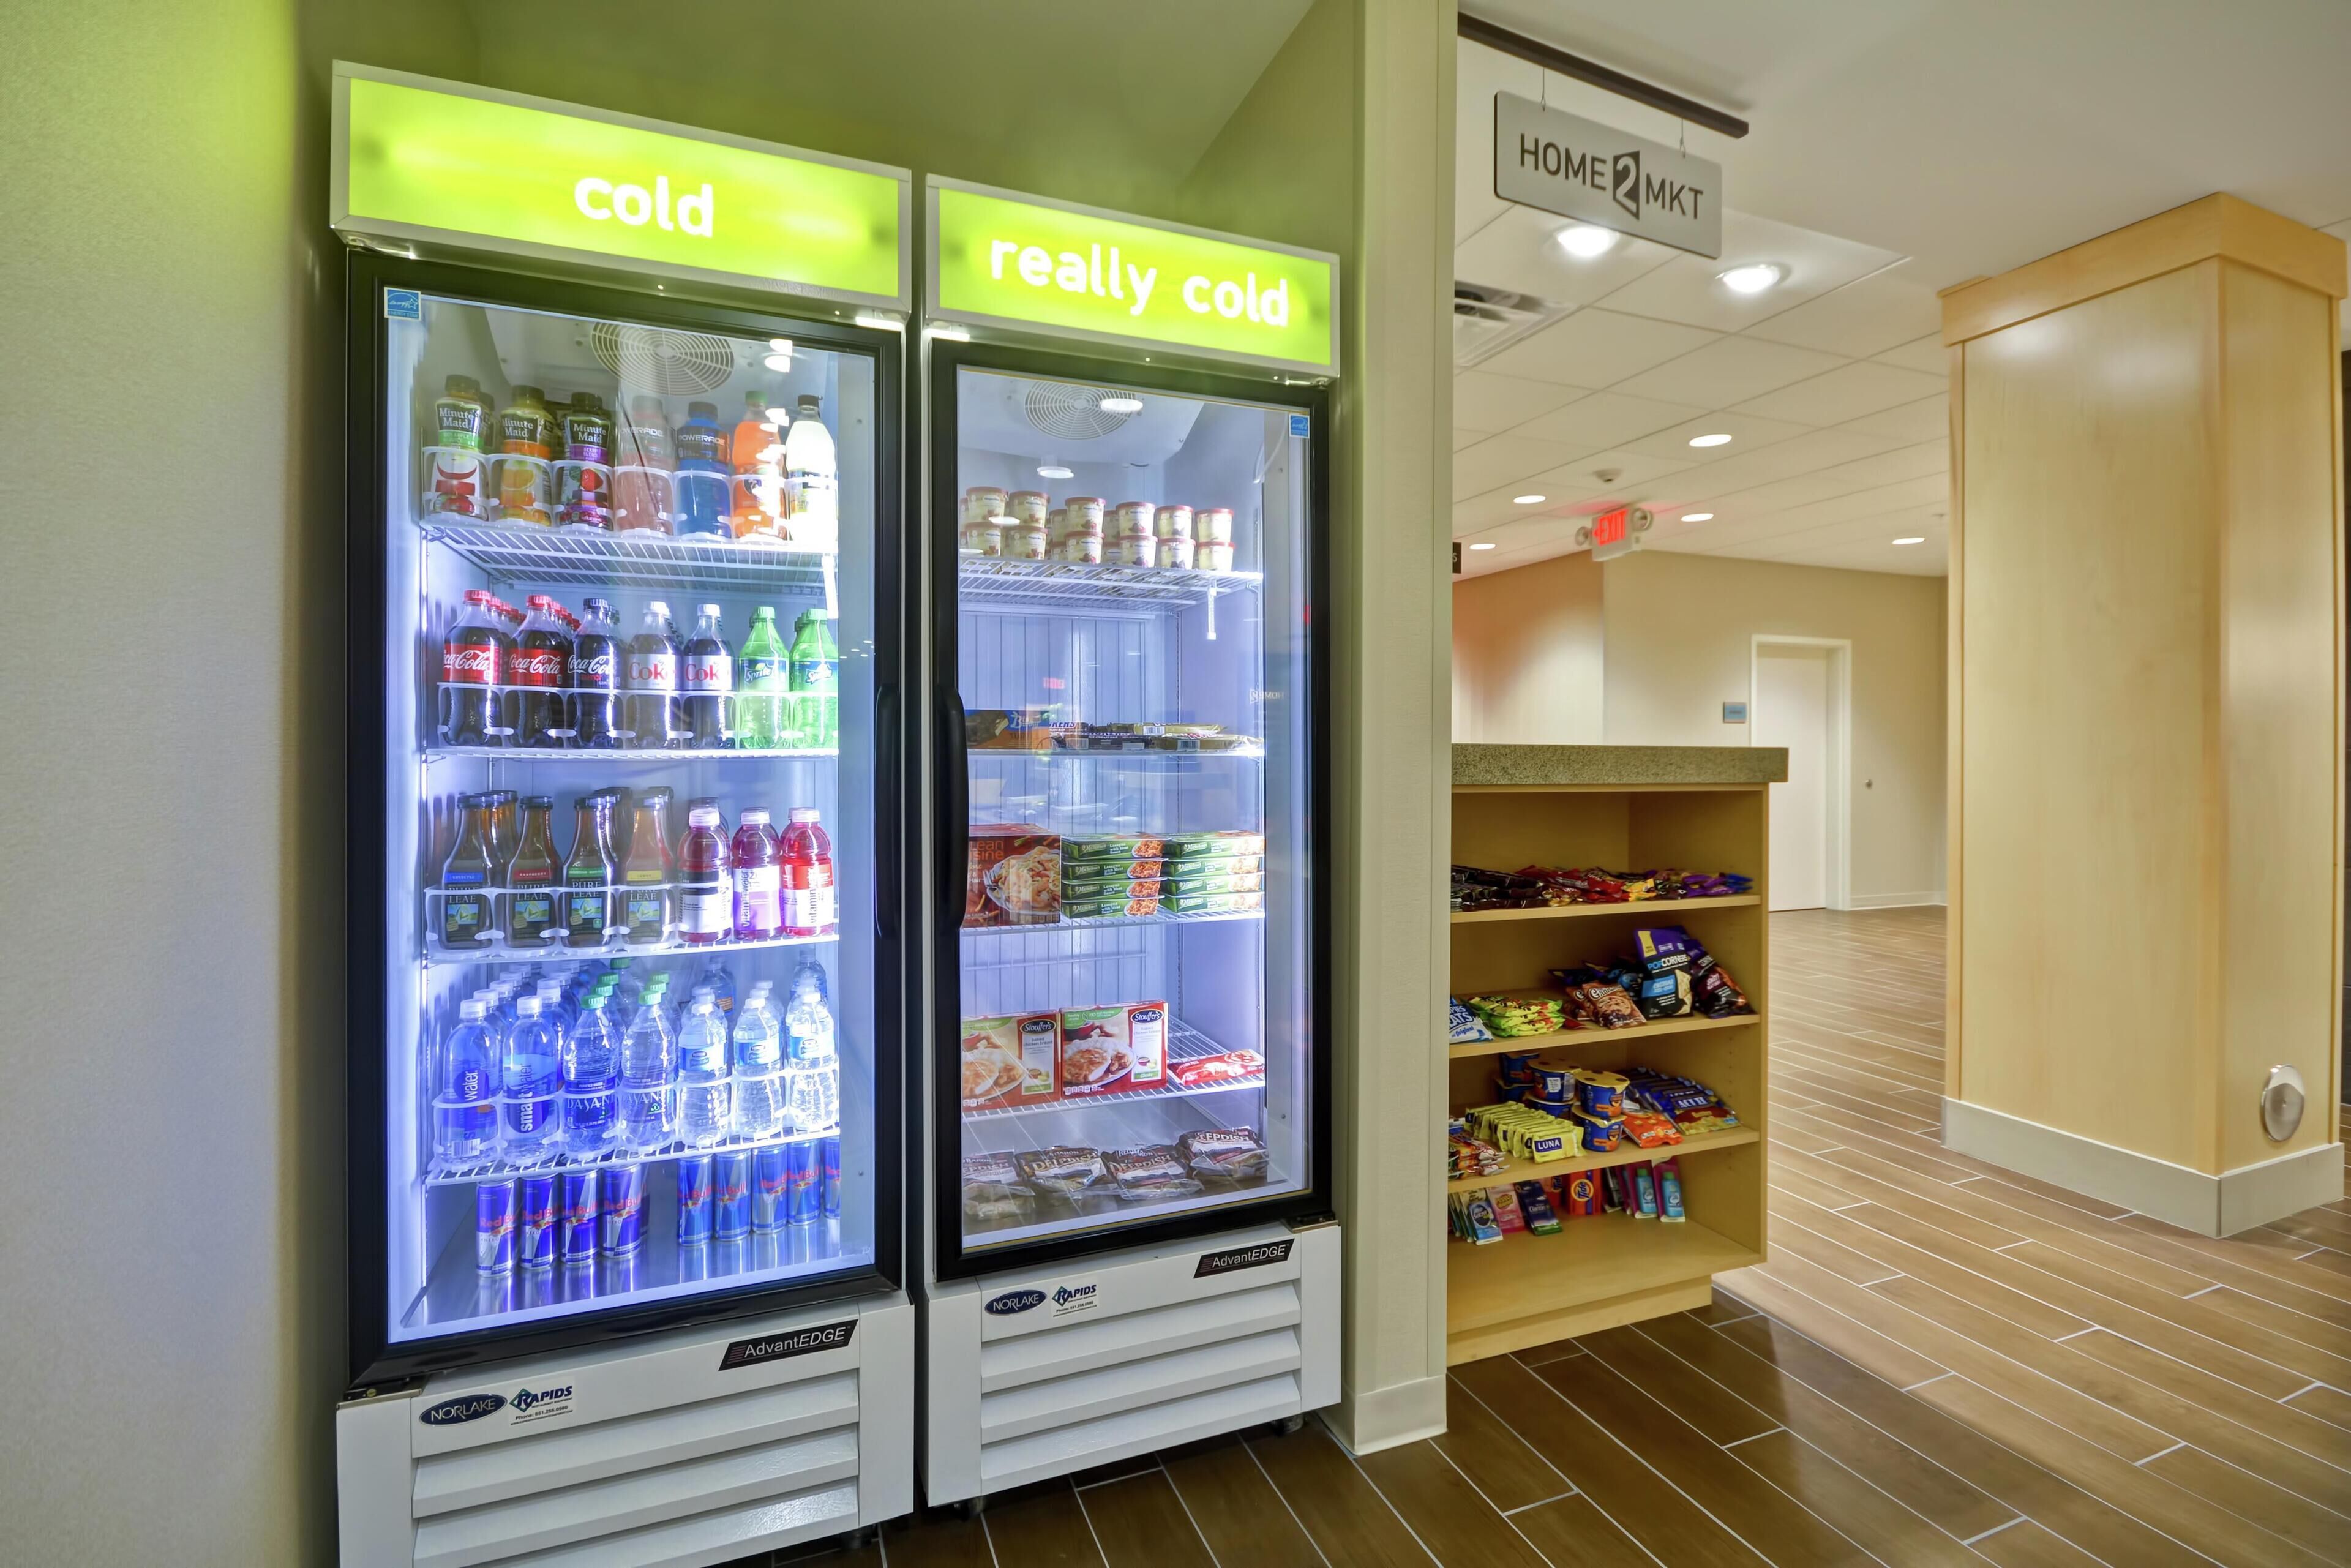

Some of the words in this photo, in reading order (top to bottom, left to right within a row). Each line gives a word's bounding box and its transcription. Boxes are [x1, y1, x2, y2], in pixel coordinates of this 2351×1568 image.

[575, 176, 714, 238] cold
[991, 239, 1157, 316] really
[1183, 272, 1288, 328] cold
[440, 408, 473, 420] Minute
[443, 417, 469, 429] Maid
[503, 418, 533, 429] Minute
[574, 423, 606, 435] Minute
[505, 427, 528, 437] Maid
[578, 432, 602, 443] Maid
[678, 435, 726, 446] POWERADE
[1598, 509, 1629, 546] EXIT
[444, 650, 490, 671] oca-Cola
[509, 654, 560, 674] Coca-Cola
[629, 662, 667, 680] Cok
[685, 664, 720, 681] Cok
[970, 840, 1003, 850] Lean
[449, 895, 476, 904] LEAF
[1134, 1011, 1160, 1021] Stouffer's
[1024, 1021, 1052, 1032] Stouffer's
[462, 1070, 478, 1101] water
[520, 1065, 533, 1133] smatwater
[1678, 1098, 1697, 1108] ACT
[1537, 1139, 1560, 1150] LUNA
[805, 1166, 819, 1179] Bull
[1577, 1181, 1590, 1199] Tide
[1212, 1245, 1286, 1267] AdvantEDGE
[994, 1293, 1039, 1311] NORLAKE
[1057, 1284, 1097, 1303] RAPIDS
[743, 1326, 845, 1358] AdvantEDGE
[517, 1386, 572, 1409] RAPIDS
[430, 1398, 496, 1422] NORLAKE
[515, 1412, 534, 1420] Phone:
